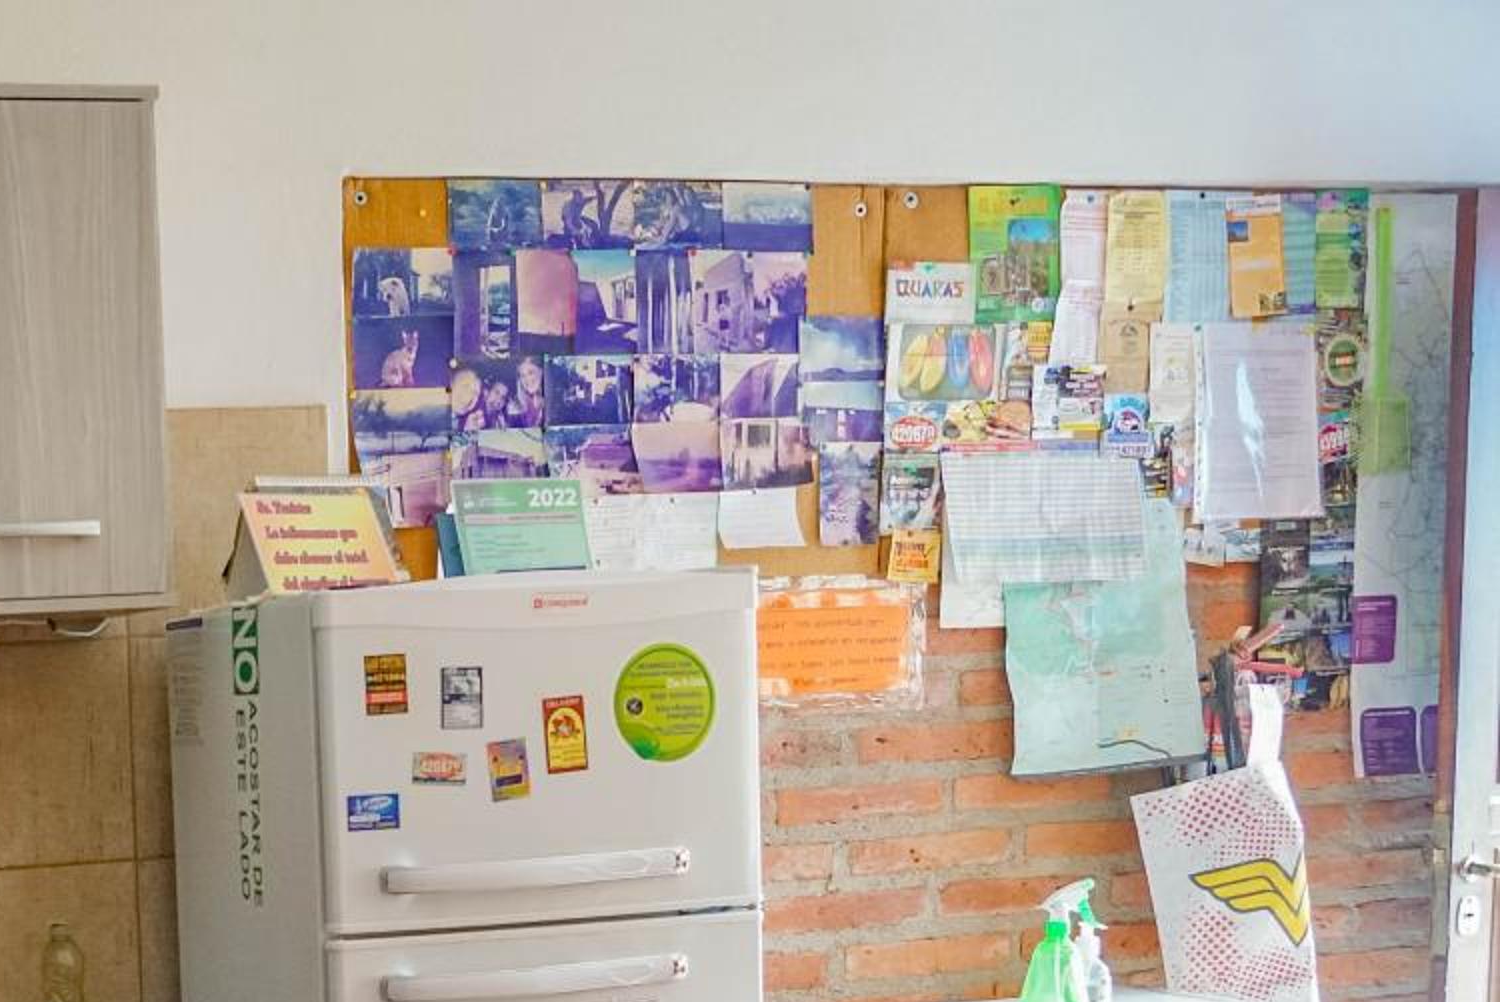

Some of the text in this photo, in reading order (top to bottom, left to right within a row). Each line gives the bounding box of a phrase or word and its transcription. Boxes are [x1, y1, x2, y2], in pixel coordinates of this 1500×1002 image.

[528, 487, 578, 508] 2022
[233, 606, 265, 908] NO ACOSTAR DE
[235, 709, 251, 901] ESTE LADO
